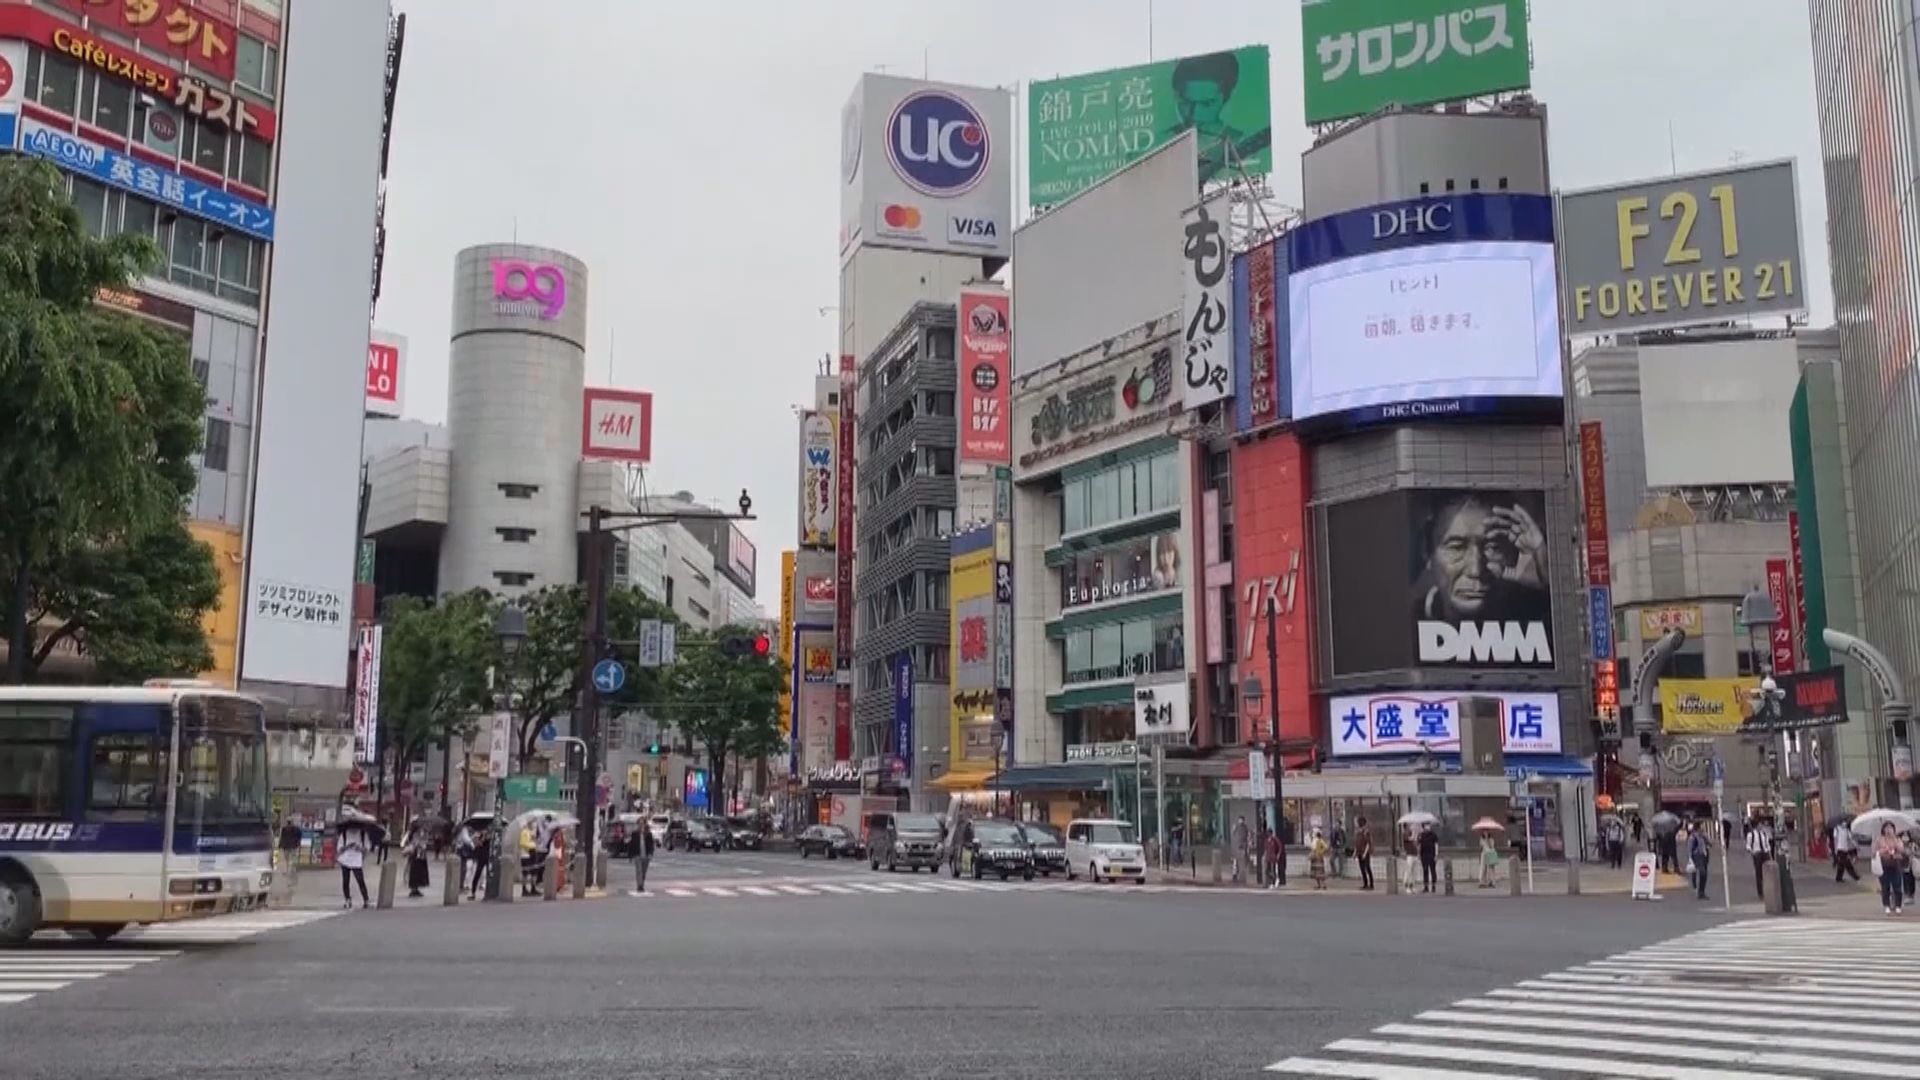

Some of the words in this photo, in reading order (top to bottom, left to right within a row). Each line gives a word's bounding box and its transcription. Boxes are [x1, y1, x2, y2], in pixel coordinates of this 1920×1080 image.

[92, 0, 228, 58] タクト
[1316, 3, 1513, 82] サロンパス
[175, 73, 257, 130] ガスト
[1039, 76, 1154, 124] 錦戸亮
[1040, 127, 1071, 142] LIVE
[1075, 120, 1117, 136] TOUR
[1122, 113, 1154, 129] 2019
[1041, 129, 1155, 164] NOMAD
[34, 133, 94, 167] AEON
[953, 216, 996, 237] VISA
[1372, 202, 1452, 238] DHC
[1617, 184, 1739, 271] F21
[491, 258, 566, 319] 109
[1185, 207, 1228, 394] もんじゃ
[1575, 266, 1745, 321] FOREVER
[1754, 259, 1794, 300] 21
[1383, 403, 1410, 418] DHC
[1412, 401, 1460, 415] Channel
[259, 584, 341, 606] ツツミプロジェクト
[1069, 573, 1147, 606] Euphoria
[1243, 549, 1300, 660] クスリ
[258, 600, 340, 624] デザイン製作中
[1418, 620, 1552, 662] DMM
[16, 823, 73, 841] BUS
